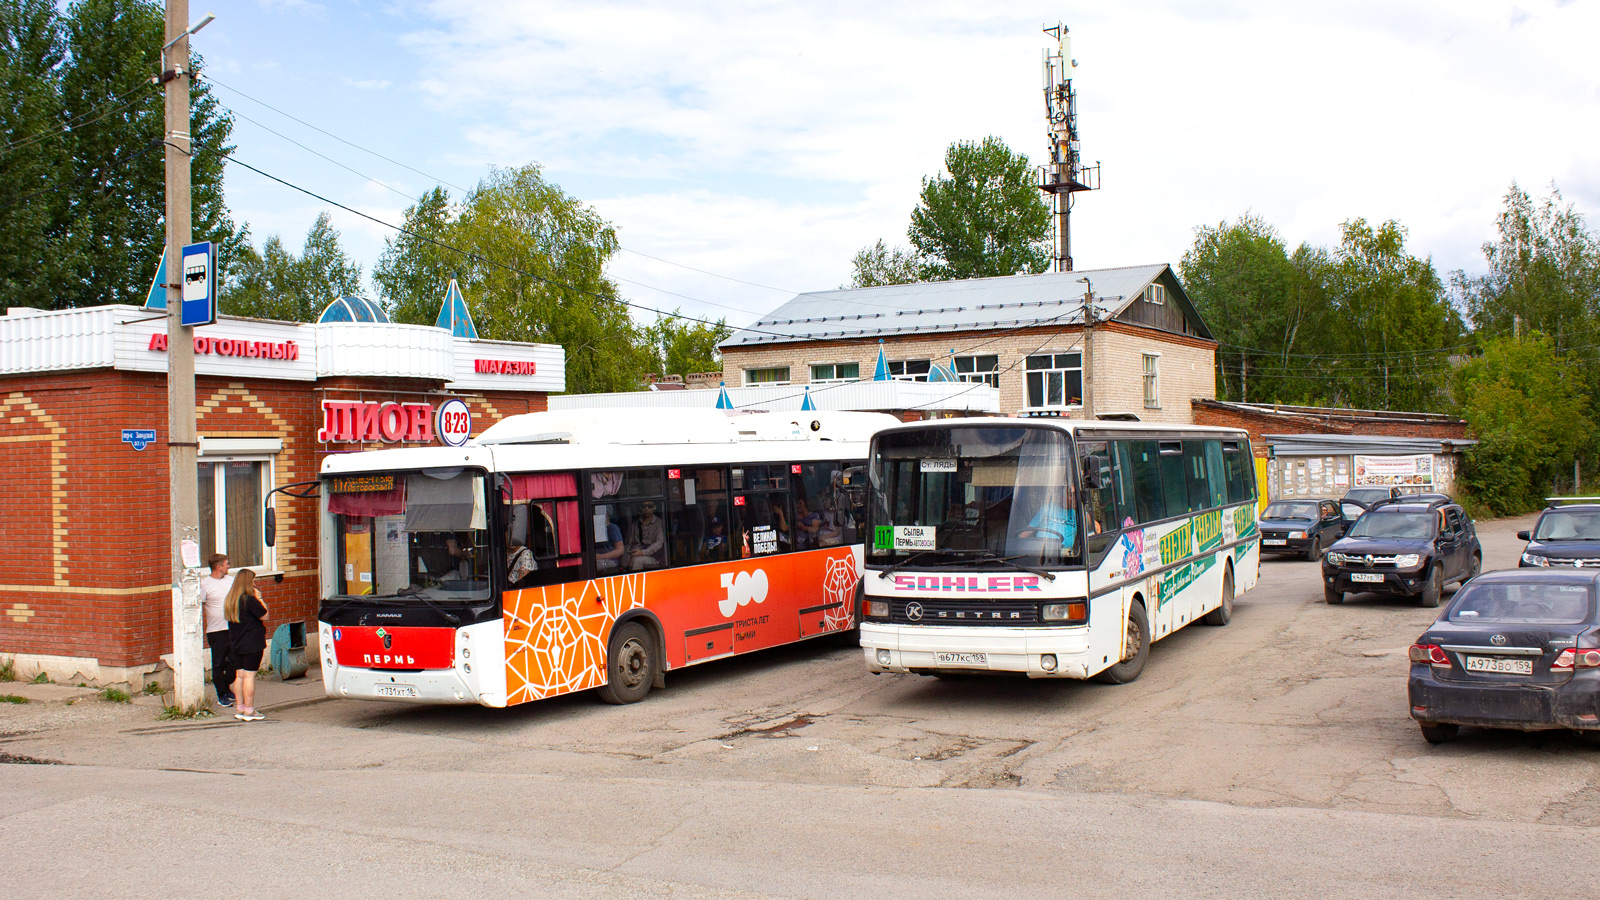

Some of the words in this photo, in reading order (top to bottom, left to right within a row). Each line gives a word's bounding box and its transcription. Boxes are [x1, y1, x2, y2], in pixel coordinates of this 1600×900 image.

[148, 333, 299, 360] АОГОЛЬНЫЙ
[474, 359, 536, 375] МАГАЗИН
[319, 401, 436, 442] ЛИОН
[933, 461, 957, 469] ЛЯДЫ
[877, 529, 892, 546] 117
[895, 576, 1042, 592] SOHLER
[718, 569, 769, 618] 300
[735, 617, 757, 629] ТРИСТА
[758, 615, 769, 625] ЛЕТ
[363, 654, 415, 664] ПЕРМЬ
[1513, 661, 1530, 670] 159
